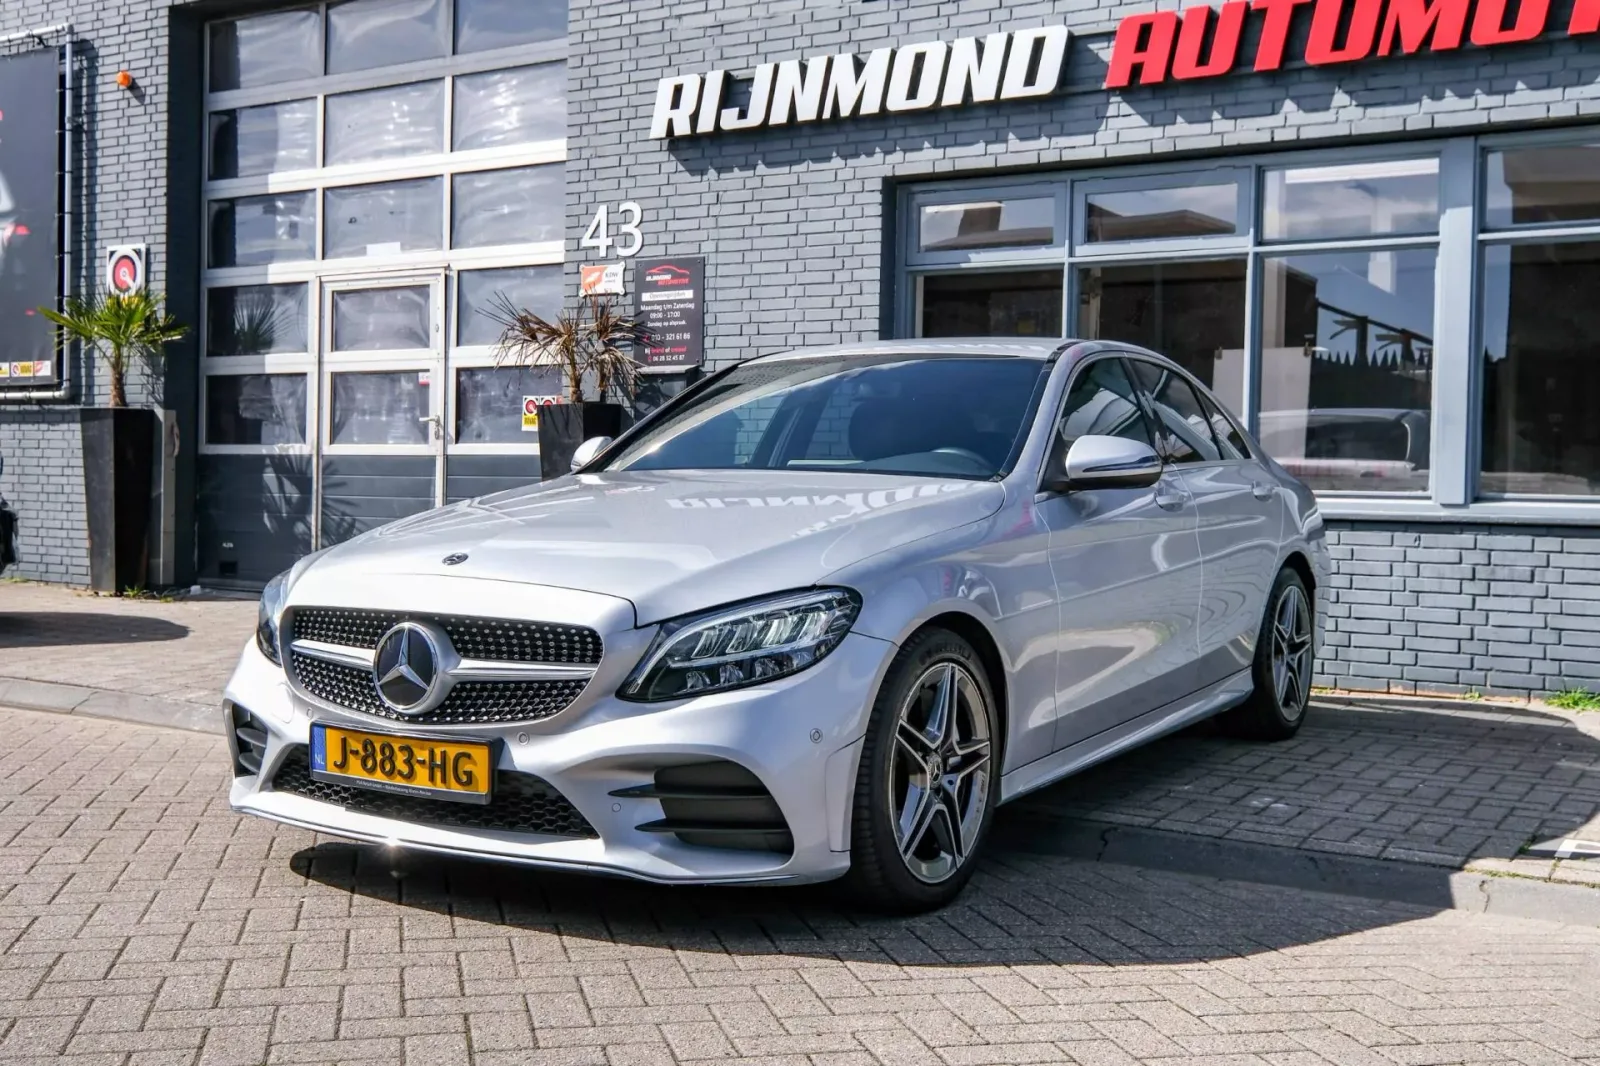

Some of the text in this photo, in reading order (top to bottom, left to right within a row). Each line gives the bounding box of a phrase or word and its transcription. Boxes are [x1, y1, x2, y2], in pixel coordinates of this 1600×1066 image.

[649, 24, 1069, 140] RIJNMOND
[582, 201, 643, 258] 43
[640, 303, 663, 311] Maandag
[673, 302, 695, 310] Zaterdag
[314, 736, 473, 787] NL J-883-HG
